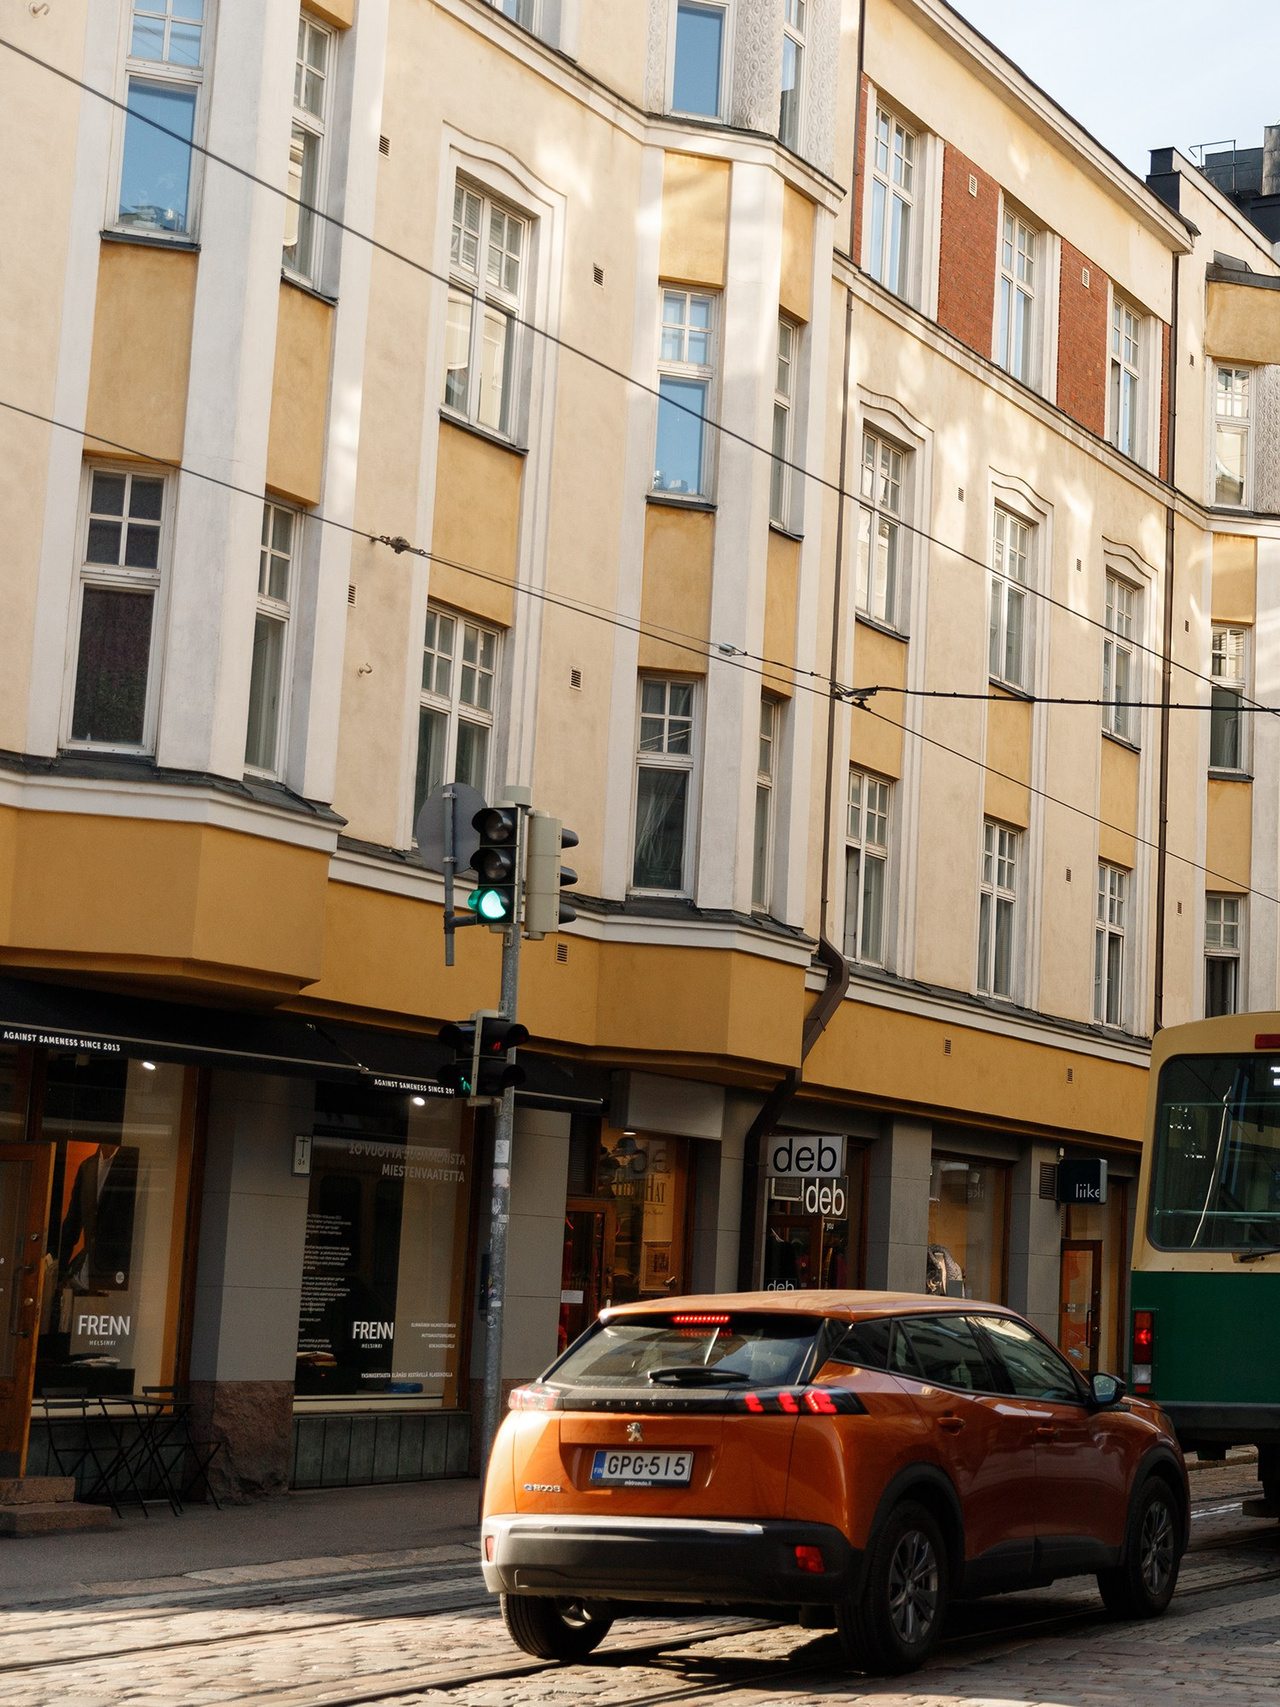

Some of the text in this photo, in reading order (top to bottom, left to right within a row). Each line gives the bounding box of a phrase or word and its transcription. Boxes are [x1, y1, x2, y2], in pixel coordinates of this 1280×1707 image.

[3, 1031, 121, 1052] AGAINST SAMENESS SINCE 2013
[374, 1079, 455, 1095] AGAINST SAMENESS SINCE 201
[773, 1138, 837, 1172] deb
[381, 1163, 465, 1183] MIESTENVAATETTA
[805, 1178, 845, 1216] deb
[1075, 1183, 1101, 1199] liike
[78, 1315, 131, 1336] FRENN
[352, 1321, 394, 1340] FRENN
[607, 1455, 686, 1476] GPG-515
